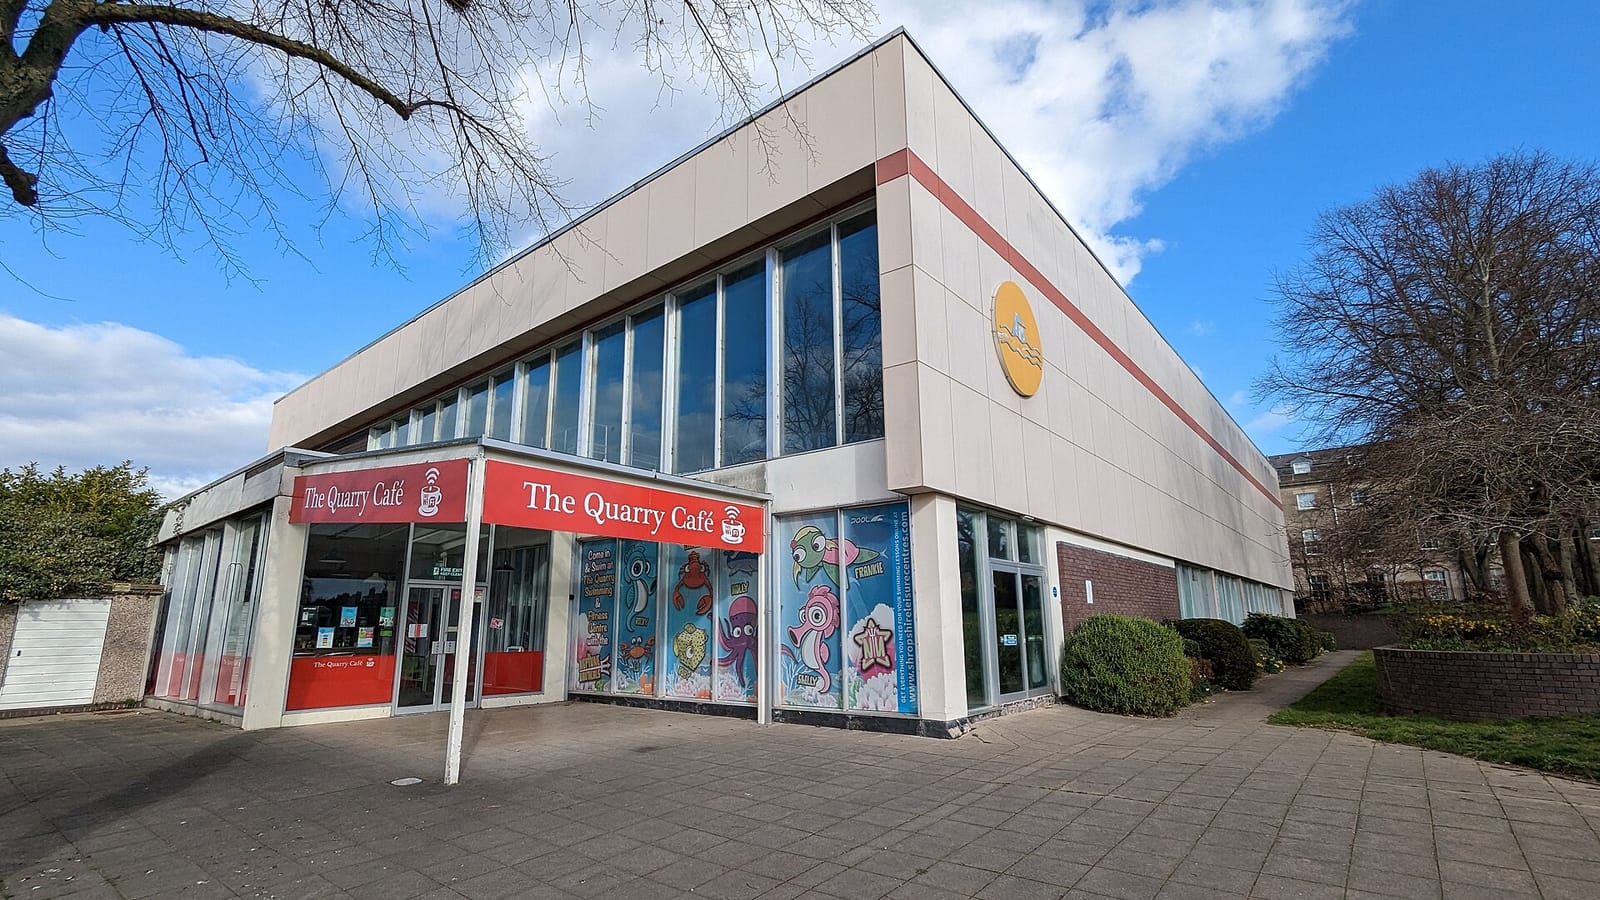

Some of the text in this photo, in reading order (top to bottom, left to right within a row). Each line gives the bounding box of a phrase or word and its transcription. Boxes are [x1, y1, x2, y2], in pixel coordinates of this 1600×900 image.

[304, 487, 324, 509] The
[327, 485, 370, 516] Quarry
[373, 480, 404, 506] Café
[522, 481, 714, 535] The Quarry Café
[588, 550, 604, 560] Come
[855, 562, 884, 579] FRANKIE
[901, 511, 916, 703] www.shropshireleisurecentres.com
[327, 661, 348, 669] Quarry
